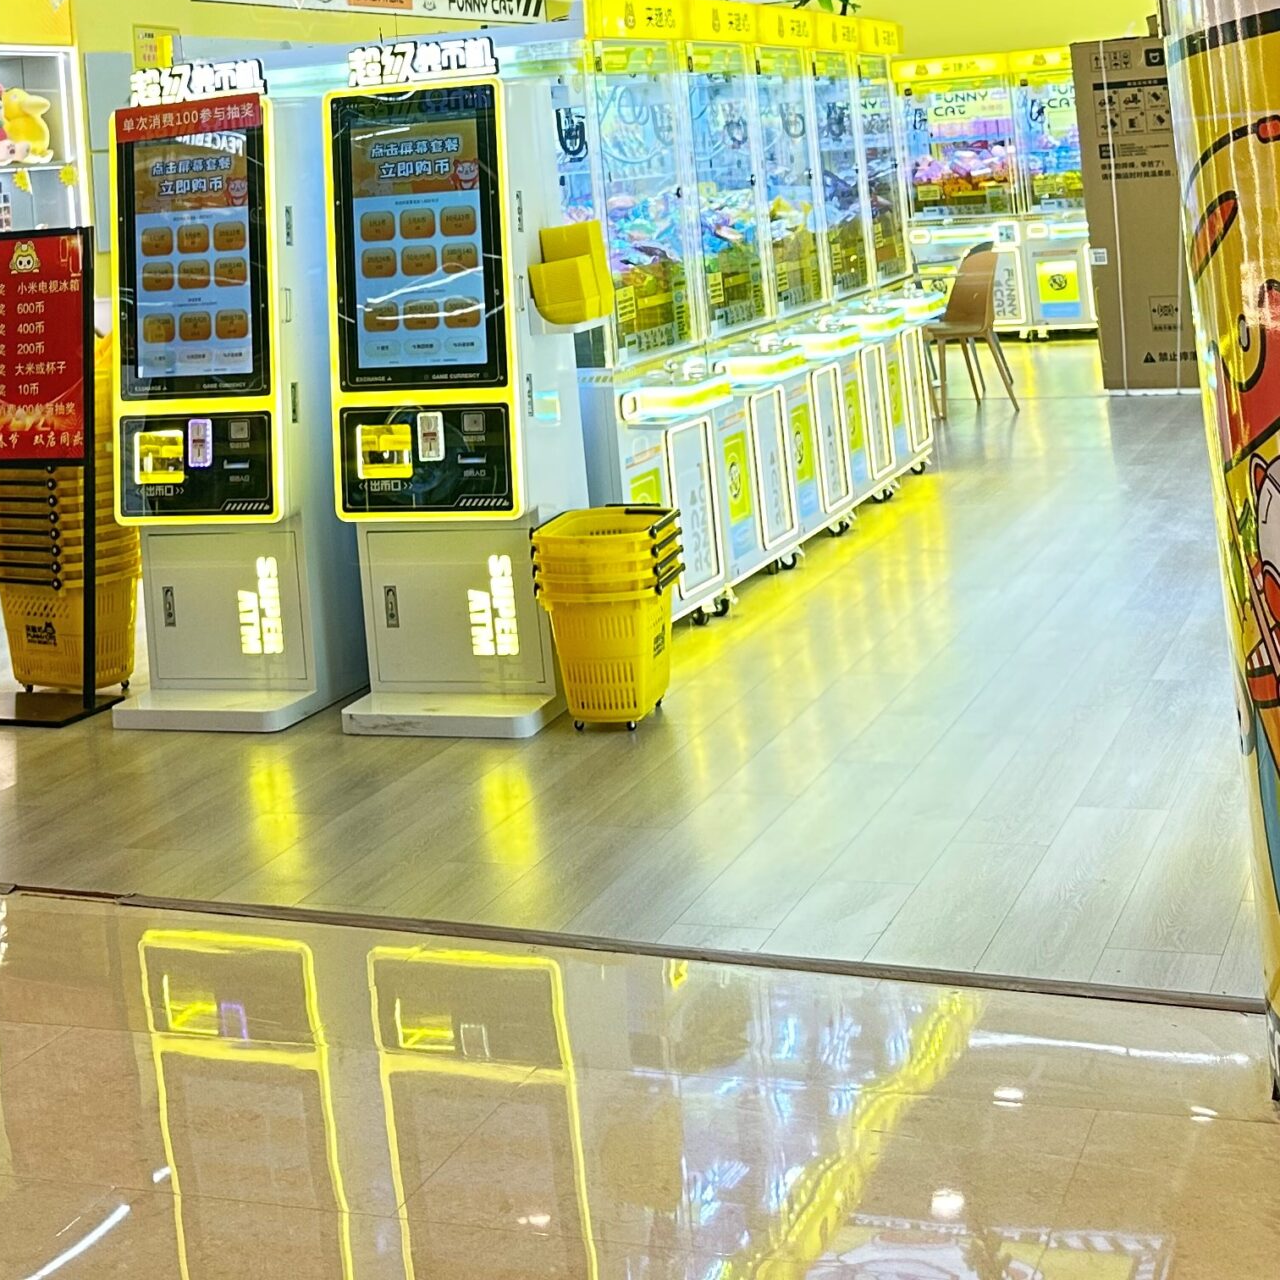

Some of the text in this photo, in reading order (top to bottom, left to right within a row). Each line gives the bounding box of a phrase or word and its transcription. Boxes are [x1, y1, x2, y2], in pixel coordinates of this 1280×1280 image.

[122, 102, 255, 133] 单次消费100参与抽奖
[370, 137, 460, 158] 点击屏幕套餐
[151, 156, 231, 177] 点击屏幕套餐
[379, 158, 450, 179] 立即购币
[160, 175, 223, 195] 立即购币
[16, 279, 80, 295] 小米电视冰箱
[16, 301, 45, 315] 600币
[16, 321, 45, 335] 400币
[16, 341, 45, 356] 200币
[14, 361, 67, 376] 大米或杯子
[18, 382, 39, 396] 10币
[146, 485, 174, 496] 出币口
[370, 480, 402, 492] 出币口
[256, 556, 284, 654] SUPER
[487, 554, 520, 657] SUPER
[237, 589, 263, 654] ATM
[466, 588, 496, 657] ATM
